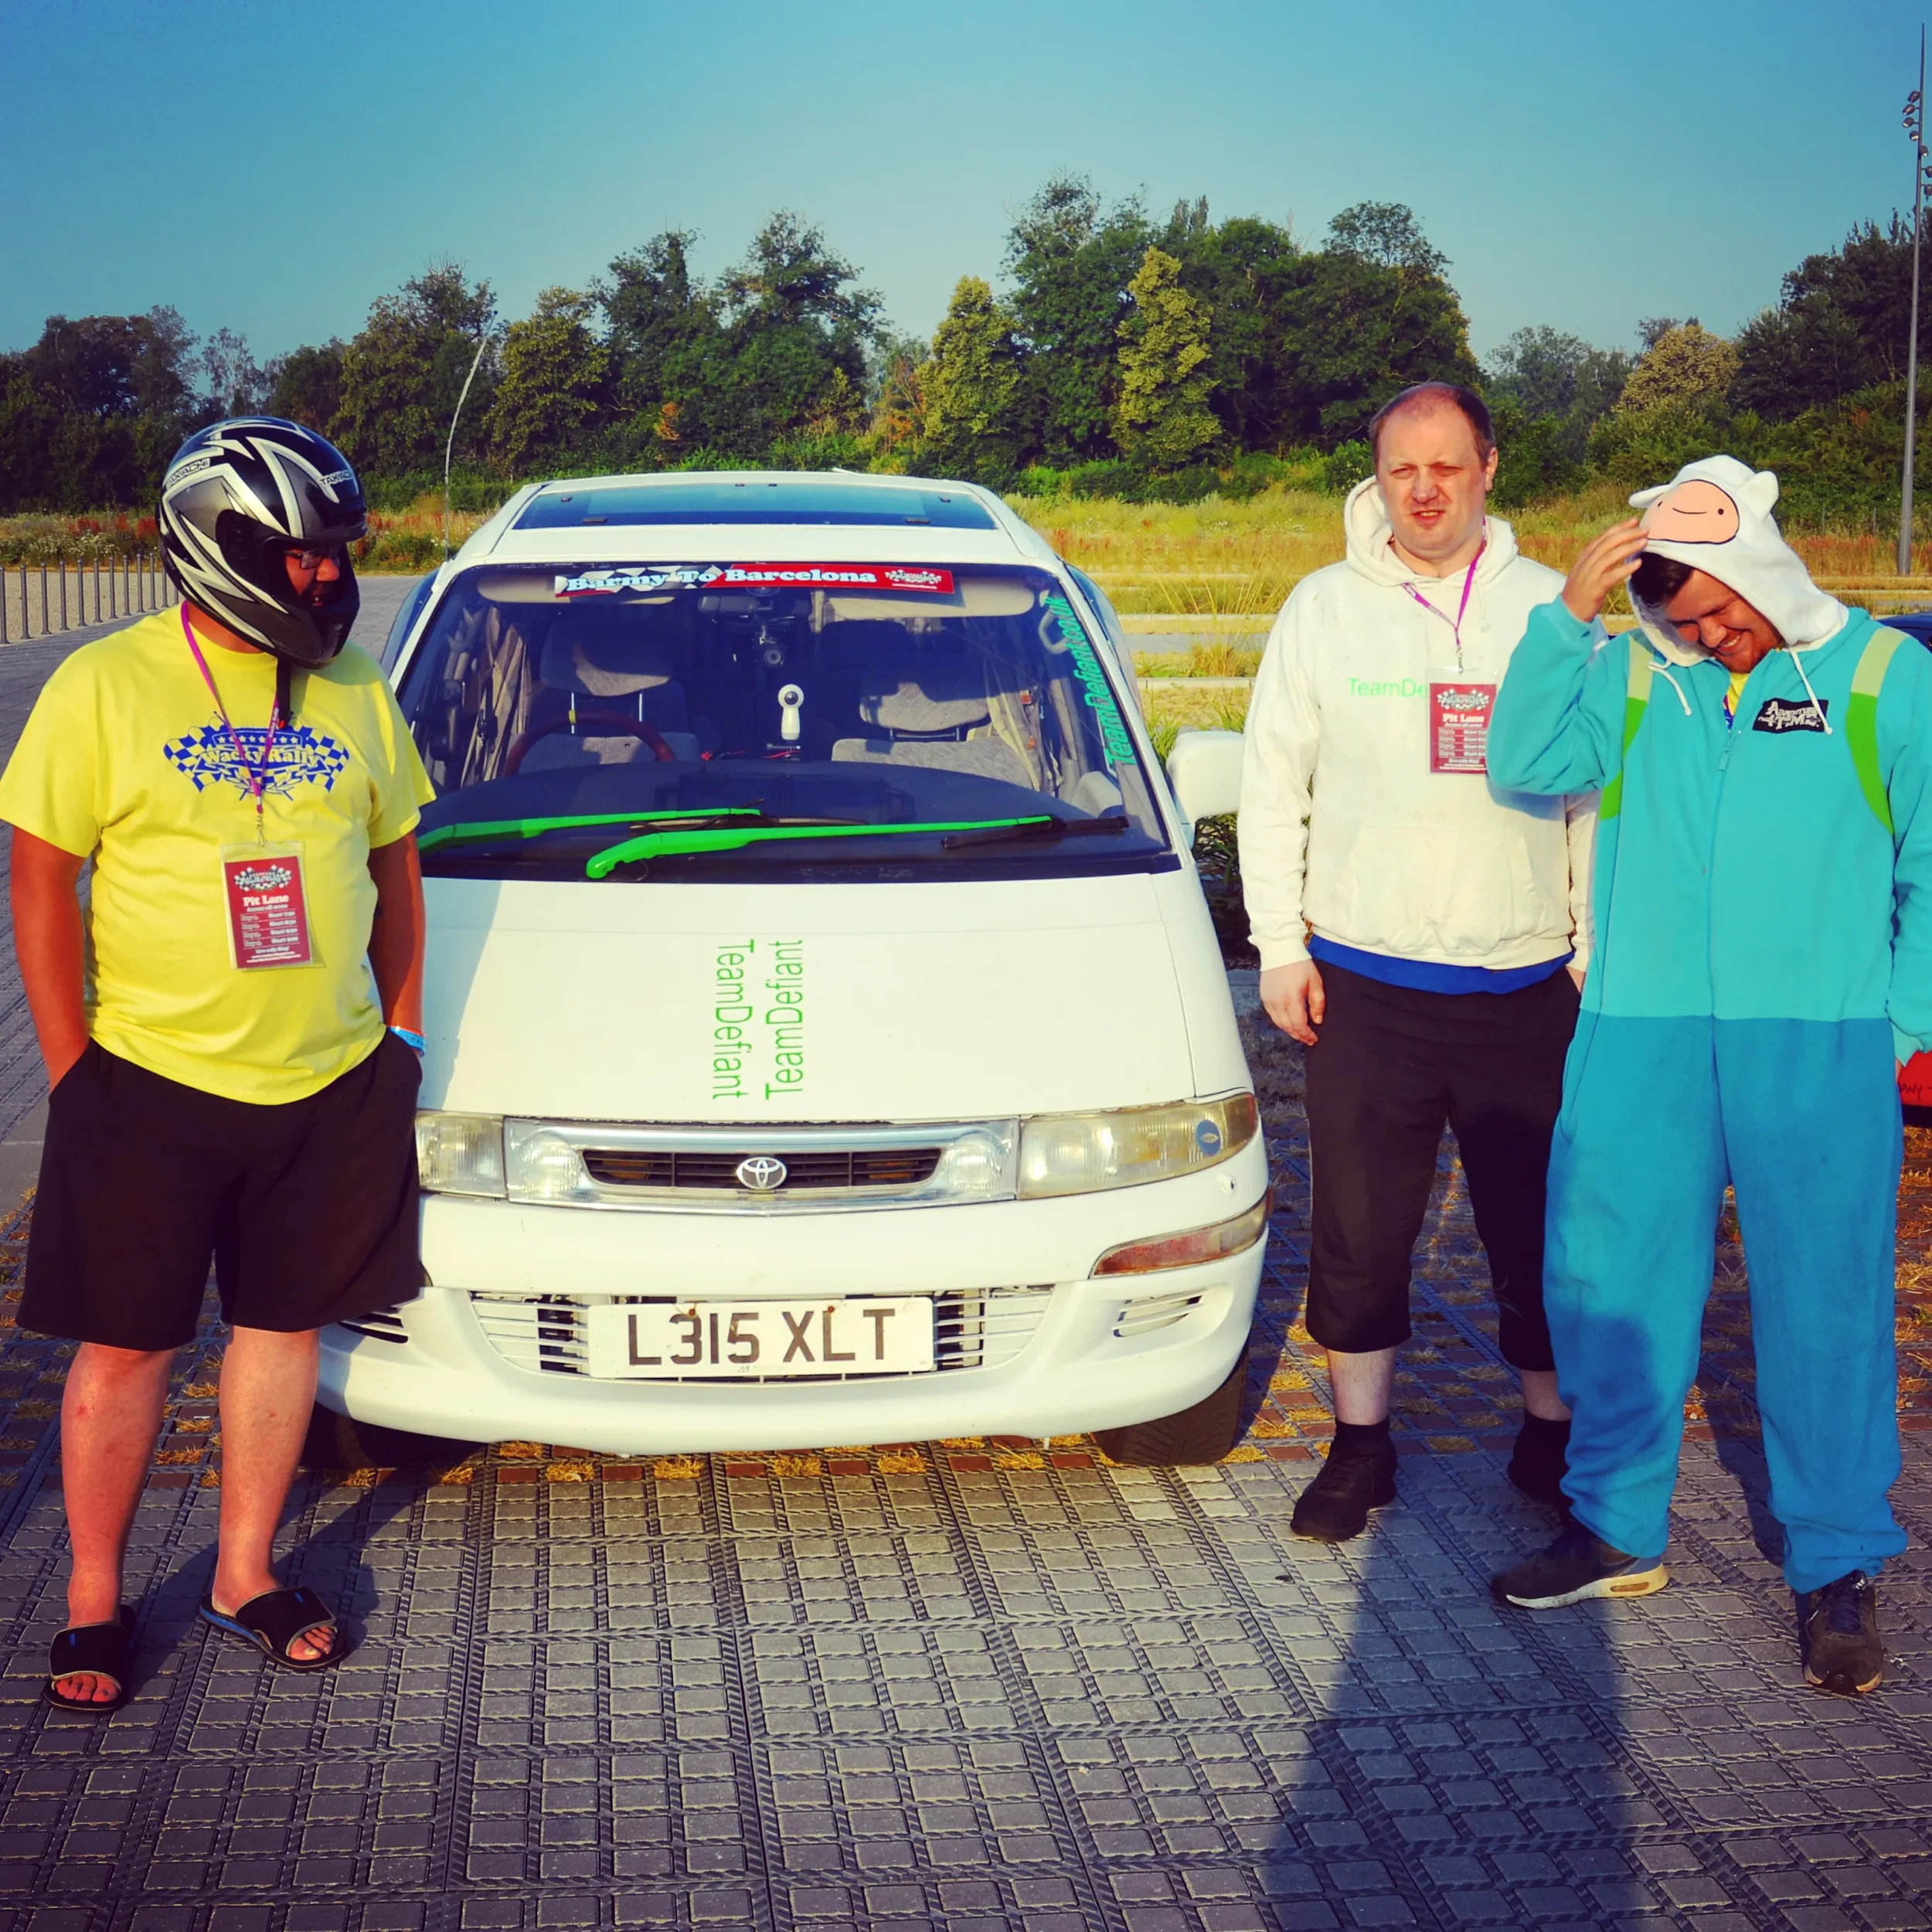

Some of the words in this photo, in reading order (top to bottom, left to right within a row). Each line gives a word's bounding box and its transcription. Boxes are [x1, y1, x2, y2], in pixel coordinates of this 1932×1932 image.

[566, 573, 669, 591] Barmy
[676, 570, 718, 583] To
[724, 569, 877, 583] Barcelona
[267, 748, 318, 767] Rally
[243, 896, 261, 907] Pit
[261, 895, 289, 905] Lane
[712, 938, 754, 1100] TeamDefiant
[765, 940, 804, 1100] TeamDefiant
[628, 1311, 760, 1366] L315
[781, 1308, 896, 1363] XLT
